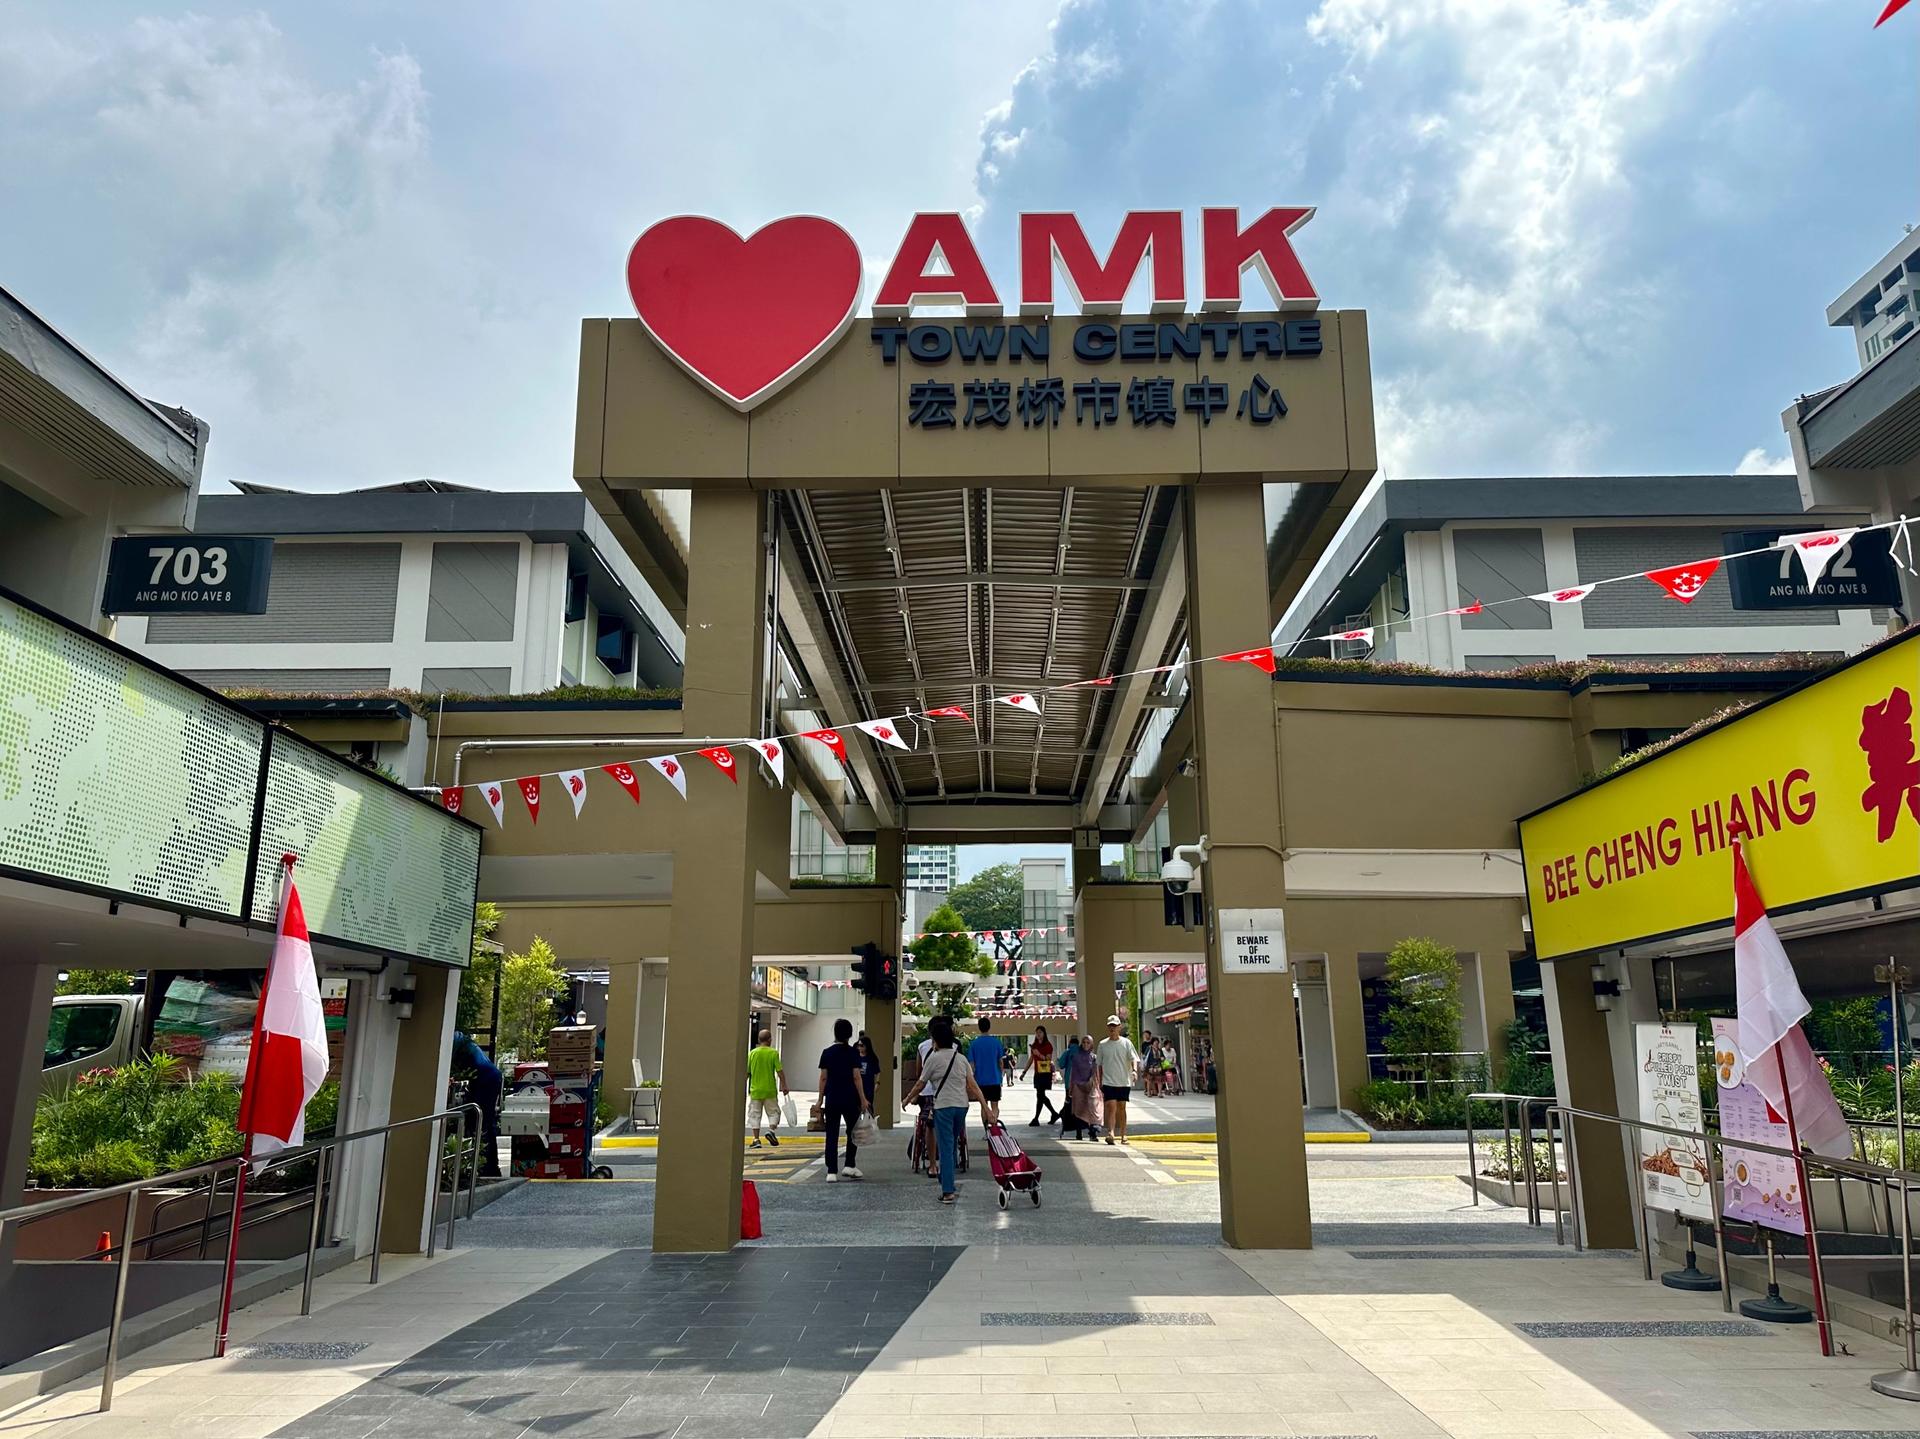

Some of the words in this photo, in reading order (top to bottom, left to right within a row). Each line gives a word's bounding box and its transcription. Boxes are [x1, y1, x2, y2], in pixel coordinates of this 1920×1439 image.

[872, 206, 1321, 317] AMK
[871, 325, 1049, 362] TOWN
[1073, 320, 1322, 361] CENTRE
[908, 374, 1288, 428] 宏茂桥市镇中心
[148, 547, 228, 586] 703
[1768, 541, 1857, 579] 72
[136, 591, 157, 601] ANG
[160, 591, 177, 601] MO
[180, 591, 199, 601] KIO
[201, 591, 223, 601] AVE
[225, 591, 231, 601] 8
[1769, 584, 1793, 596] ANG
[1818, 584, 1836, 594] KIO
[1839, 583, 1859, 594] AVE
[1862, 583, 1868, 594] 8
[1543, 855, 1580, 903] BEE
[1585, 817, 1682, 889] CHENG
[1691, 768, 1816, 856] HIANG
[1237, 936, 1269, 945] BEWARE
[1249, 946, 1258, 954] OF
[1239, 955, 1270, 964] TRAFFIC
[1658, 1052, 1682, 1064] CRISPY
[1674, 1064, 1696, 1076] PORK
[1657, 1073, 1687, 1088] TWIST
